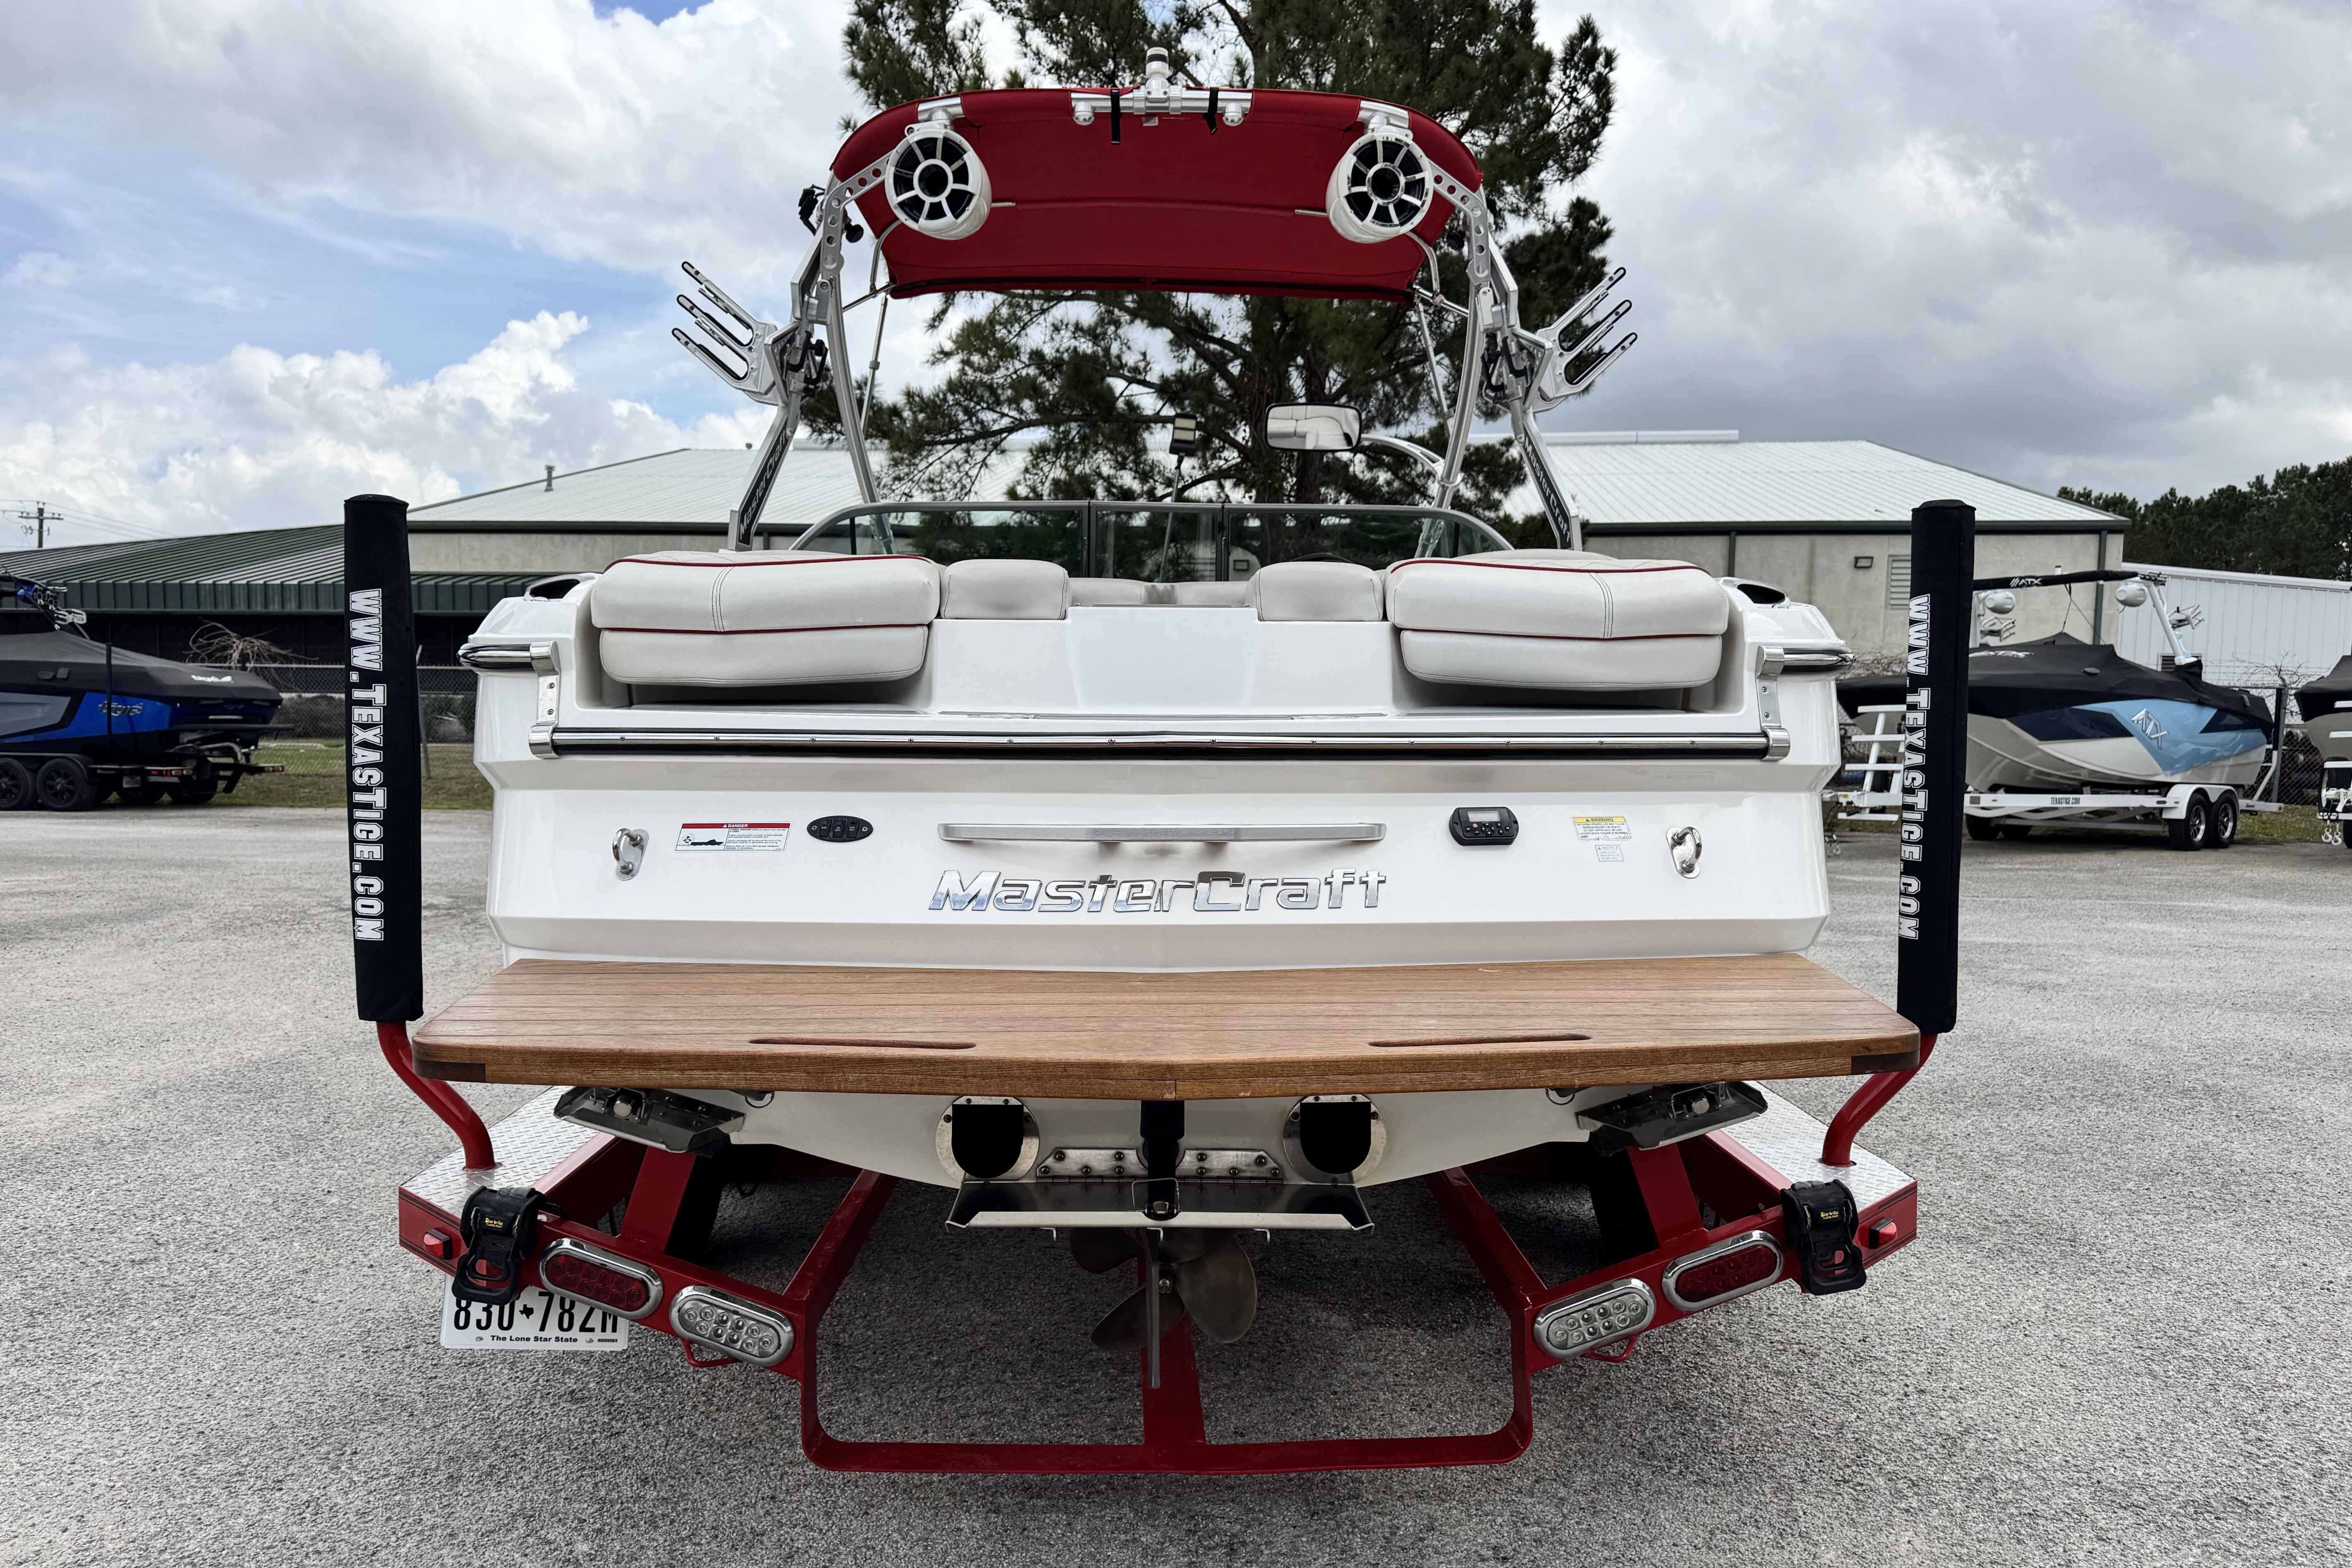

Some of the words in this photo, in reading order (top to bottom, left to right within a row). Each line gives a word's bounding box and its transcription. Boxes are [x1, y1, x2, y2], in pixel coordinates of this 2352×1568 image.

[740, 430, 786, 540] MasterCraft
[1525, 436, 1570, 542] MasterCraft
[350, 588, 386, 941] WWW.TEXASTIGE.COM
[1898, 594, 1931, 940] WWWTEXASTIGECOM
[929, 868, 1386, 912] MasterCraft
